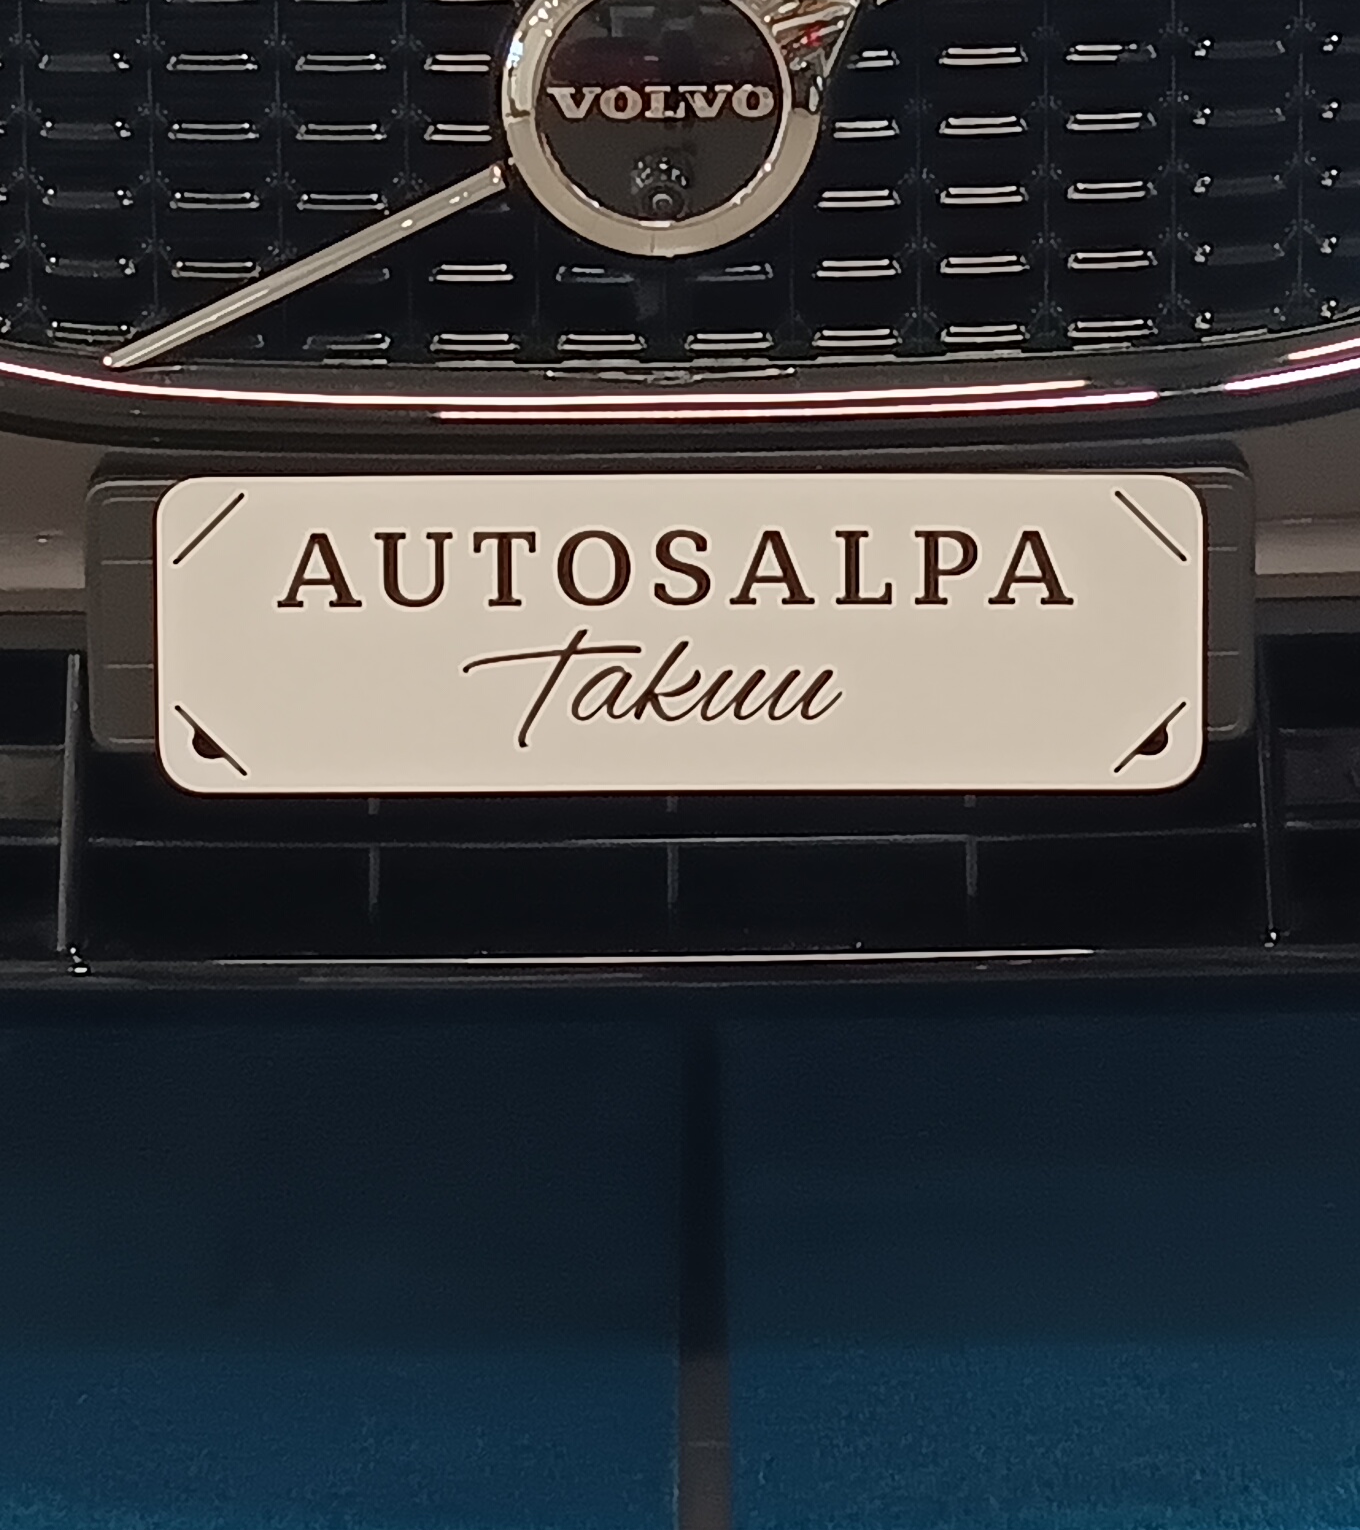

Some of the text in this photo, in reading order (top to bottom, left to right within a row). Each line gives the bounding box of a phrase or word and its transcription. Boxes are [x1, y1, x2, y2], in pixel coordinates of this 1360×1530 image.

[546, 84, 775, 120] VOLVO
[277, 529, 1075, 608] AUTOSALPA
[462, 628, 843, 748] Takuu
